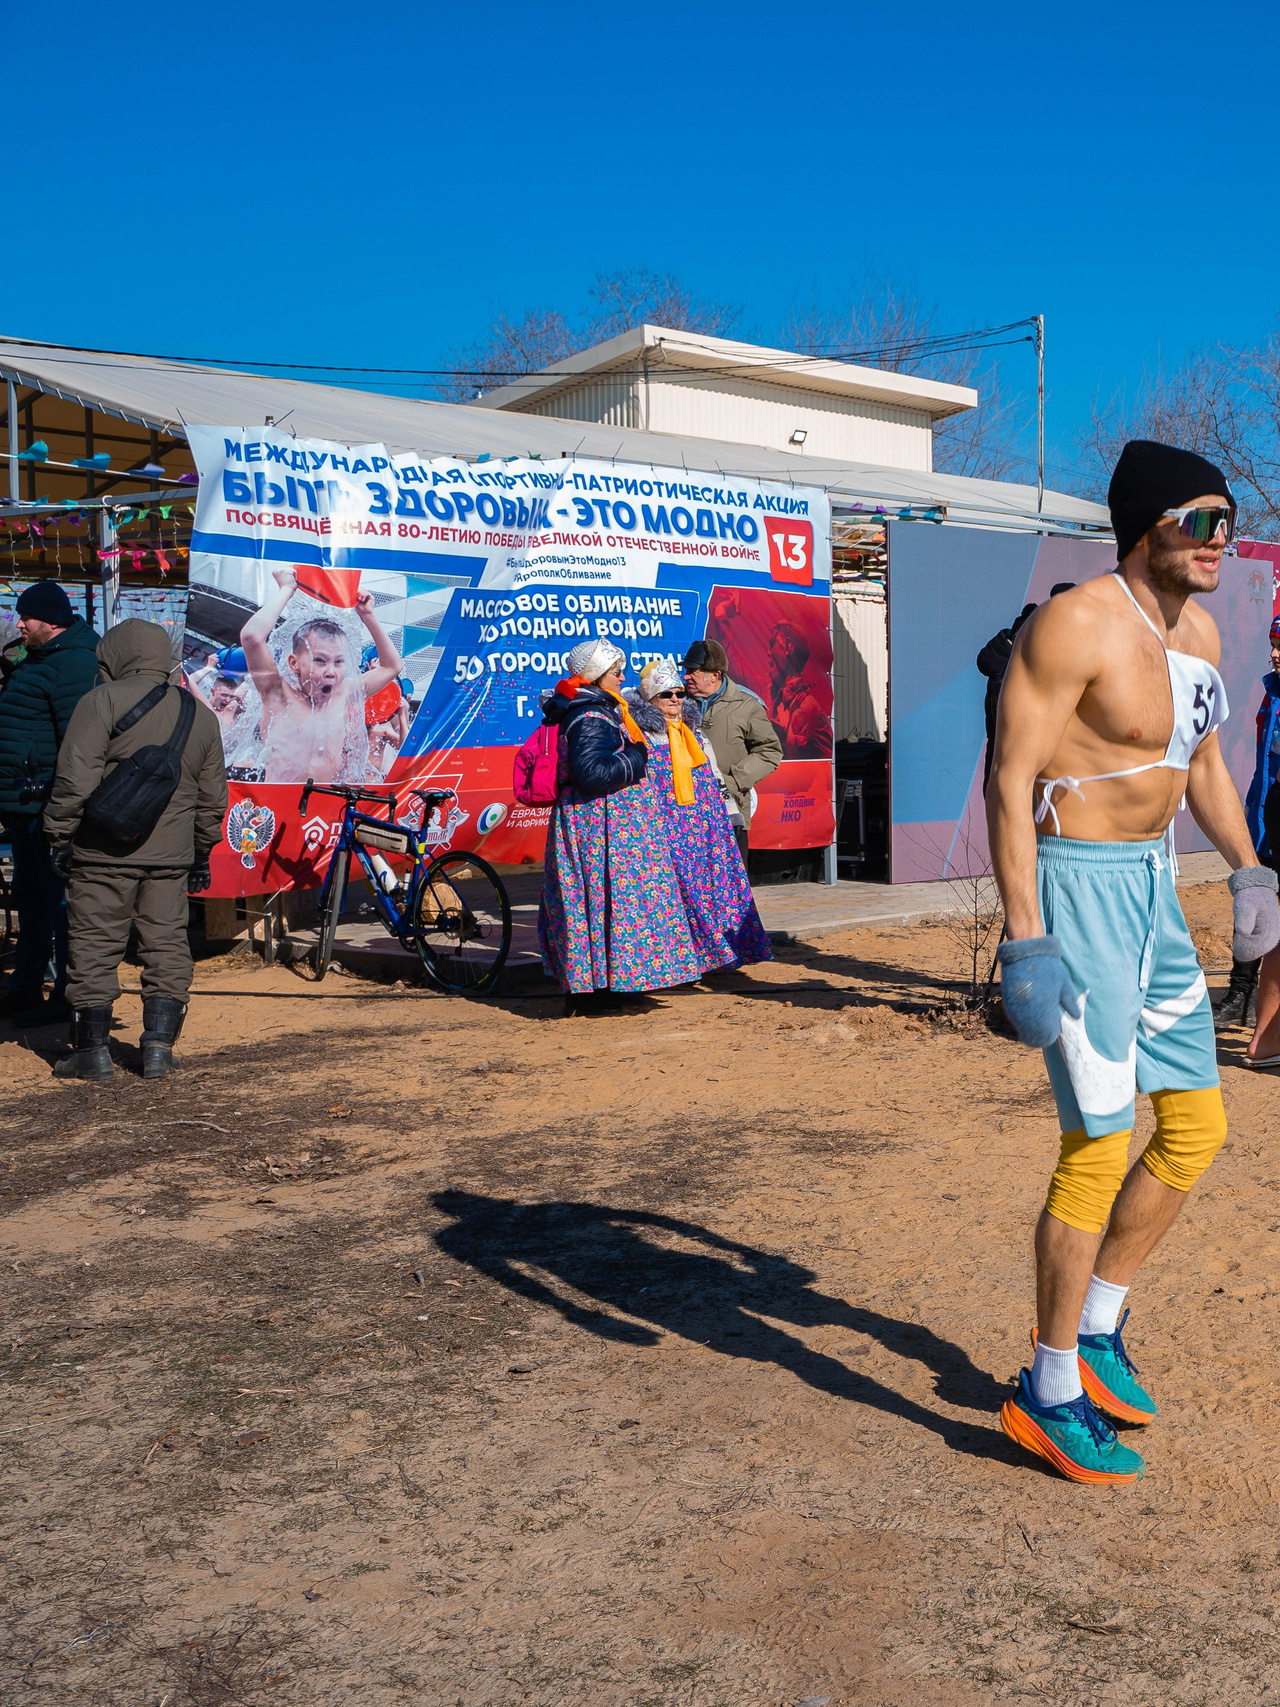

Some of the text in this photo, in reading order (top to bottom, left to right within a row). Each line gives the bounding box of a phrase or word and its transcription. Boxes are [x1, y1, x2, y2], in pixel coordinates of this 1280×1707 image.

[366, 481, 552, 530] ЗДОРОВЫМ
[571, 497, 636, 530] ЭТО
[641, 504, 759, 543] МОДНО
[753, 493, 809, 516] АКЦИЯ
[397, 522, 481, 545] 80-ЛЕТИЮ
[485, 531, 526, 550] ПОБЕДЫ
[532, 531, 603, 548] ВЕЛИКОЙ
[606, 535, 718, 557] ОТЕЧЕСТВЕННОЙ
[721, 544, 761, 561] ВОЙНЕ
[771, 533, 807, 570] 13
[460, 593, 682, 619] МАССОВОЕ ОБЛИВАНИЕ
[478, 614, 664, 643] ХОЛОДНОЙ ВОДОЙ
[453, 655, 485, 683] 50
[1193, 682, 1215, 735] 5
[781, 809, 802, 822] НКО
[783, 797, 816, 808] ХОЛДИНГ
[506, 819, 515, 828] И
